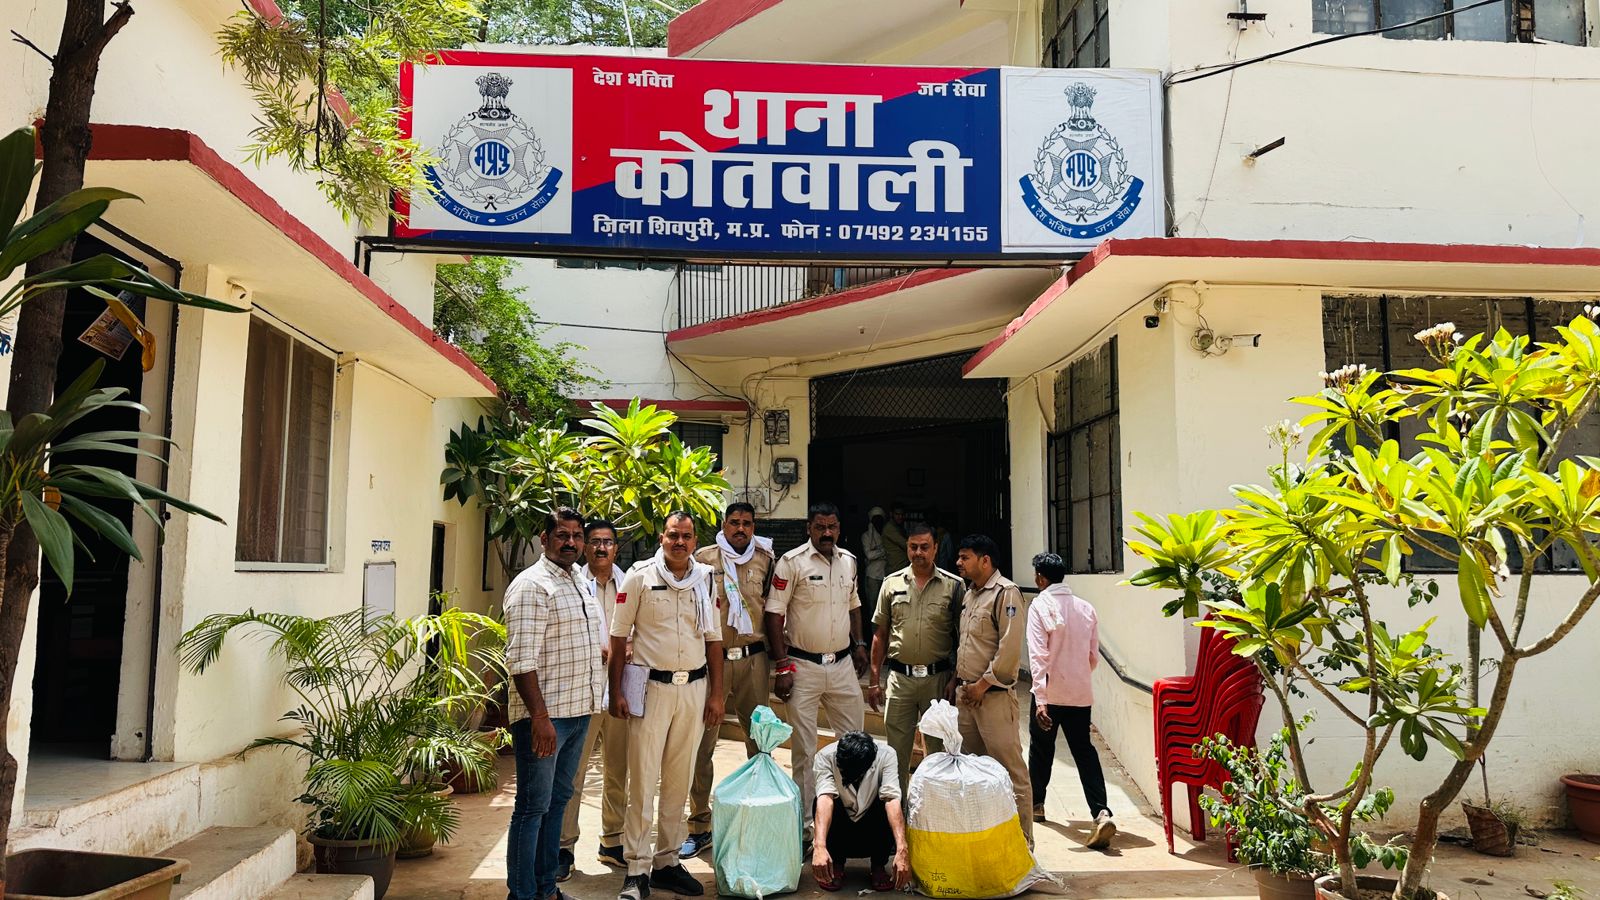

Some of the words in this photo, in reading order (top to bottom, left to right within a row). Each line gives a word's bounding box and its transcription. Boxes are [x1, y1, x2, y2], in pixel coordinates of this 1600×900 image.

[592, 67, 623, 86] देश
[627, 69, 675, 88] भक्ति
[917, 82, 948, 97] जन
[952, 79, 987, 97] सेवा
[703, 88, 883, 148] थाना
[609, 130, 973, 213] कोतवाली
[505, 209, 527, 222] जन
[530, 195, 547, 209] सेवा
[1034, 205, 1046, 221] देश
[1095, 219, 1115, 233] जन
[1115, 206, 1131, 220] सेवा
[648, 216, 720, 242] शिवपुरी,
[726, 222, 770, 238] म.प्र.
[838, 224, 904, 240] 07492
[909, 225, 988, 242] 234155
